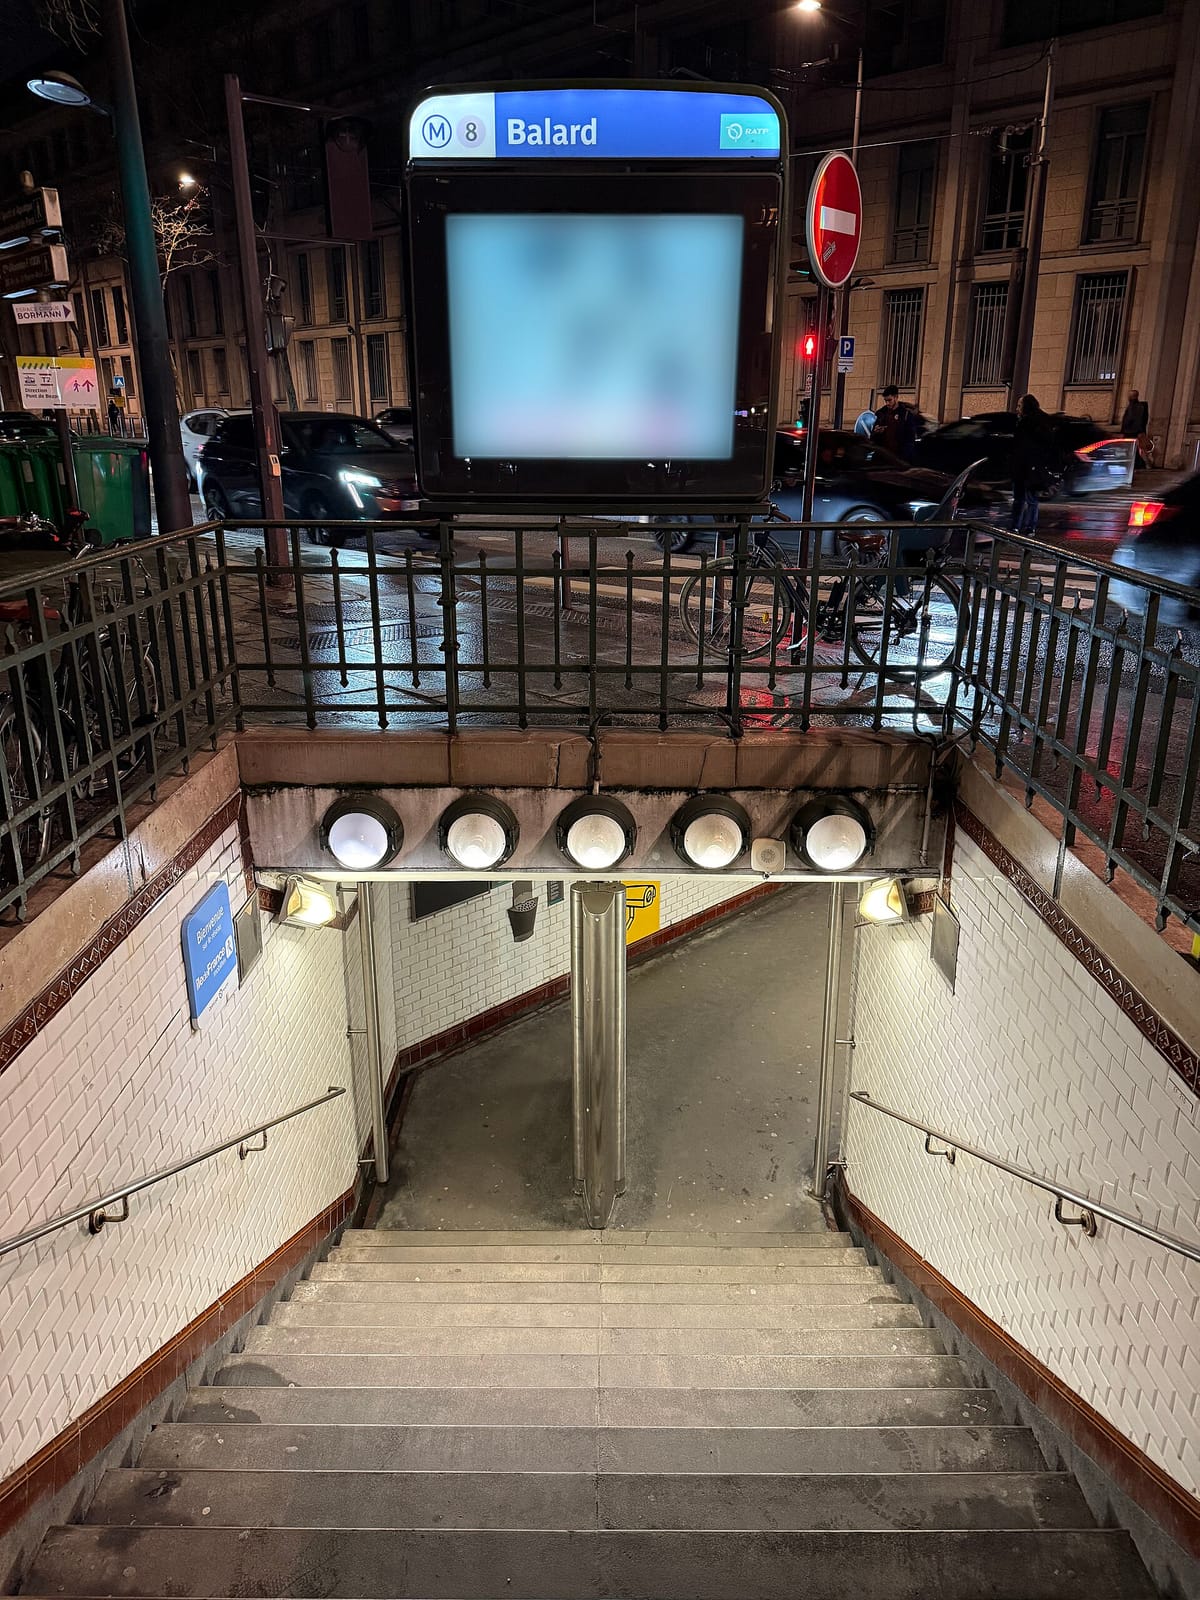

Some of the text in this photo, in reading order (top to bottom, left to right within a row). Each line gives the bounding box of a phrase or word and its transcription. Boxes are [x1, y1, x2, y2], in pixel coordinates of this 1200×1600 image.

[429, 117, 597, 146] M 8 Balard
[17, 311, 61, 319] BORMANN
[843, 341, 851, 354] P
[197, 906, 224, 944] Bienvenue
